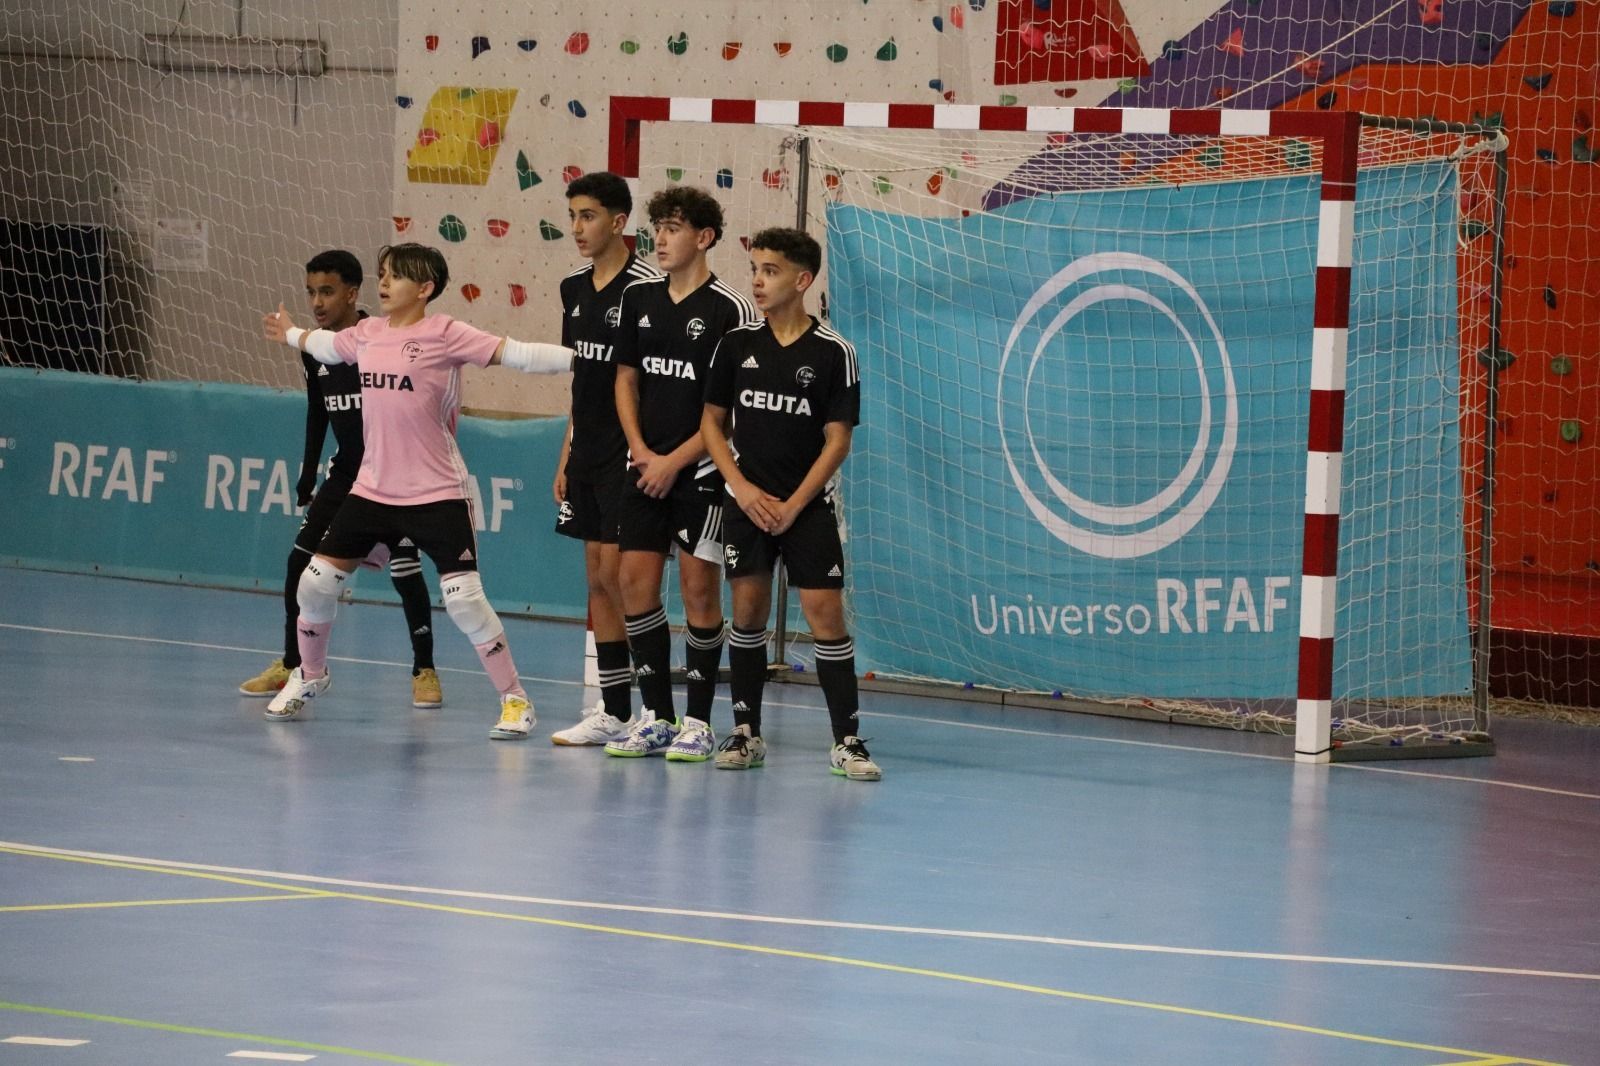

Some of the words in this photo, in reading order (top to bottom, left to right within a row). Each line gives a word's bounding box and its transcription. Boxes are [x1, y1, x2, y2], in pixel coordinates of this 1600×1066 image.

[575, 340, 614, 362] EUT
[642, 356, 696, 380] CEUTA
[324, 393, 362, 412] EUT
[740, 389, 812, 416] CEUTA
[204, 454, 323, 516] RFA
